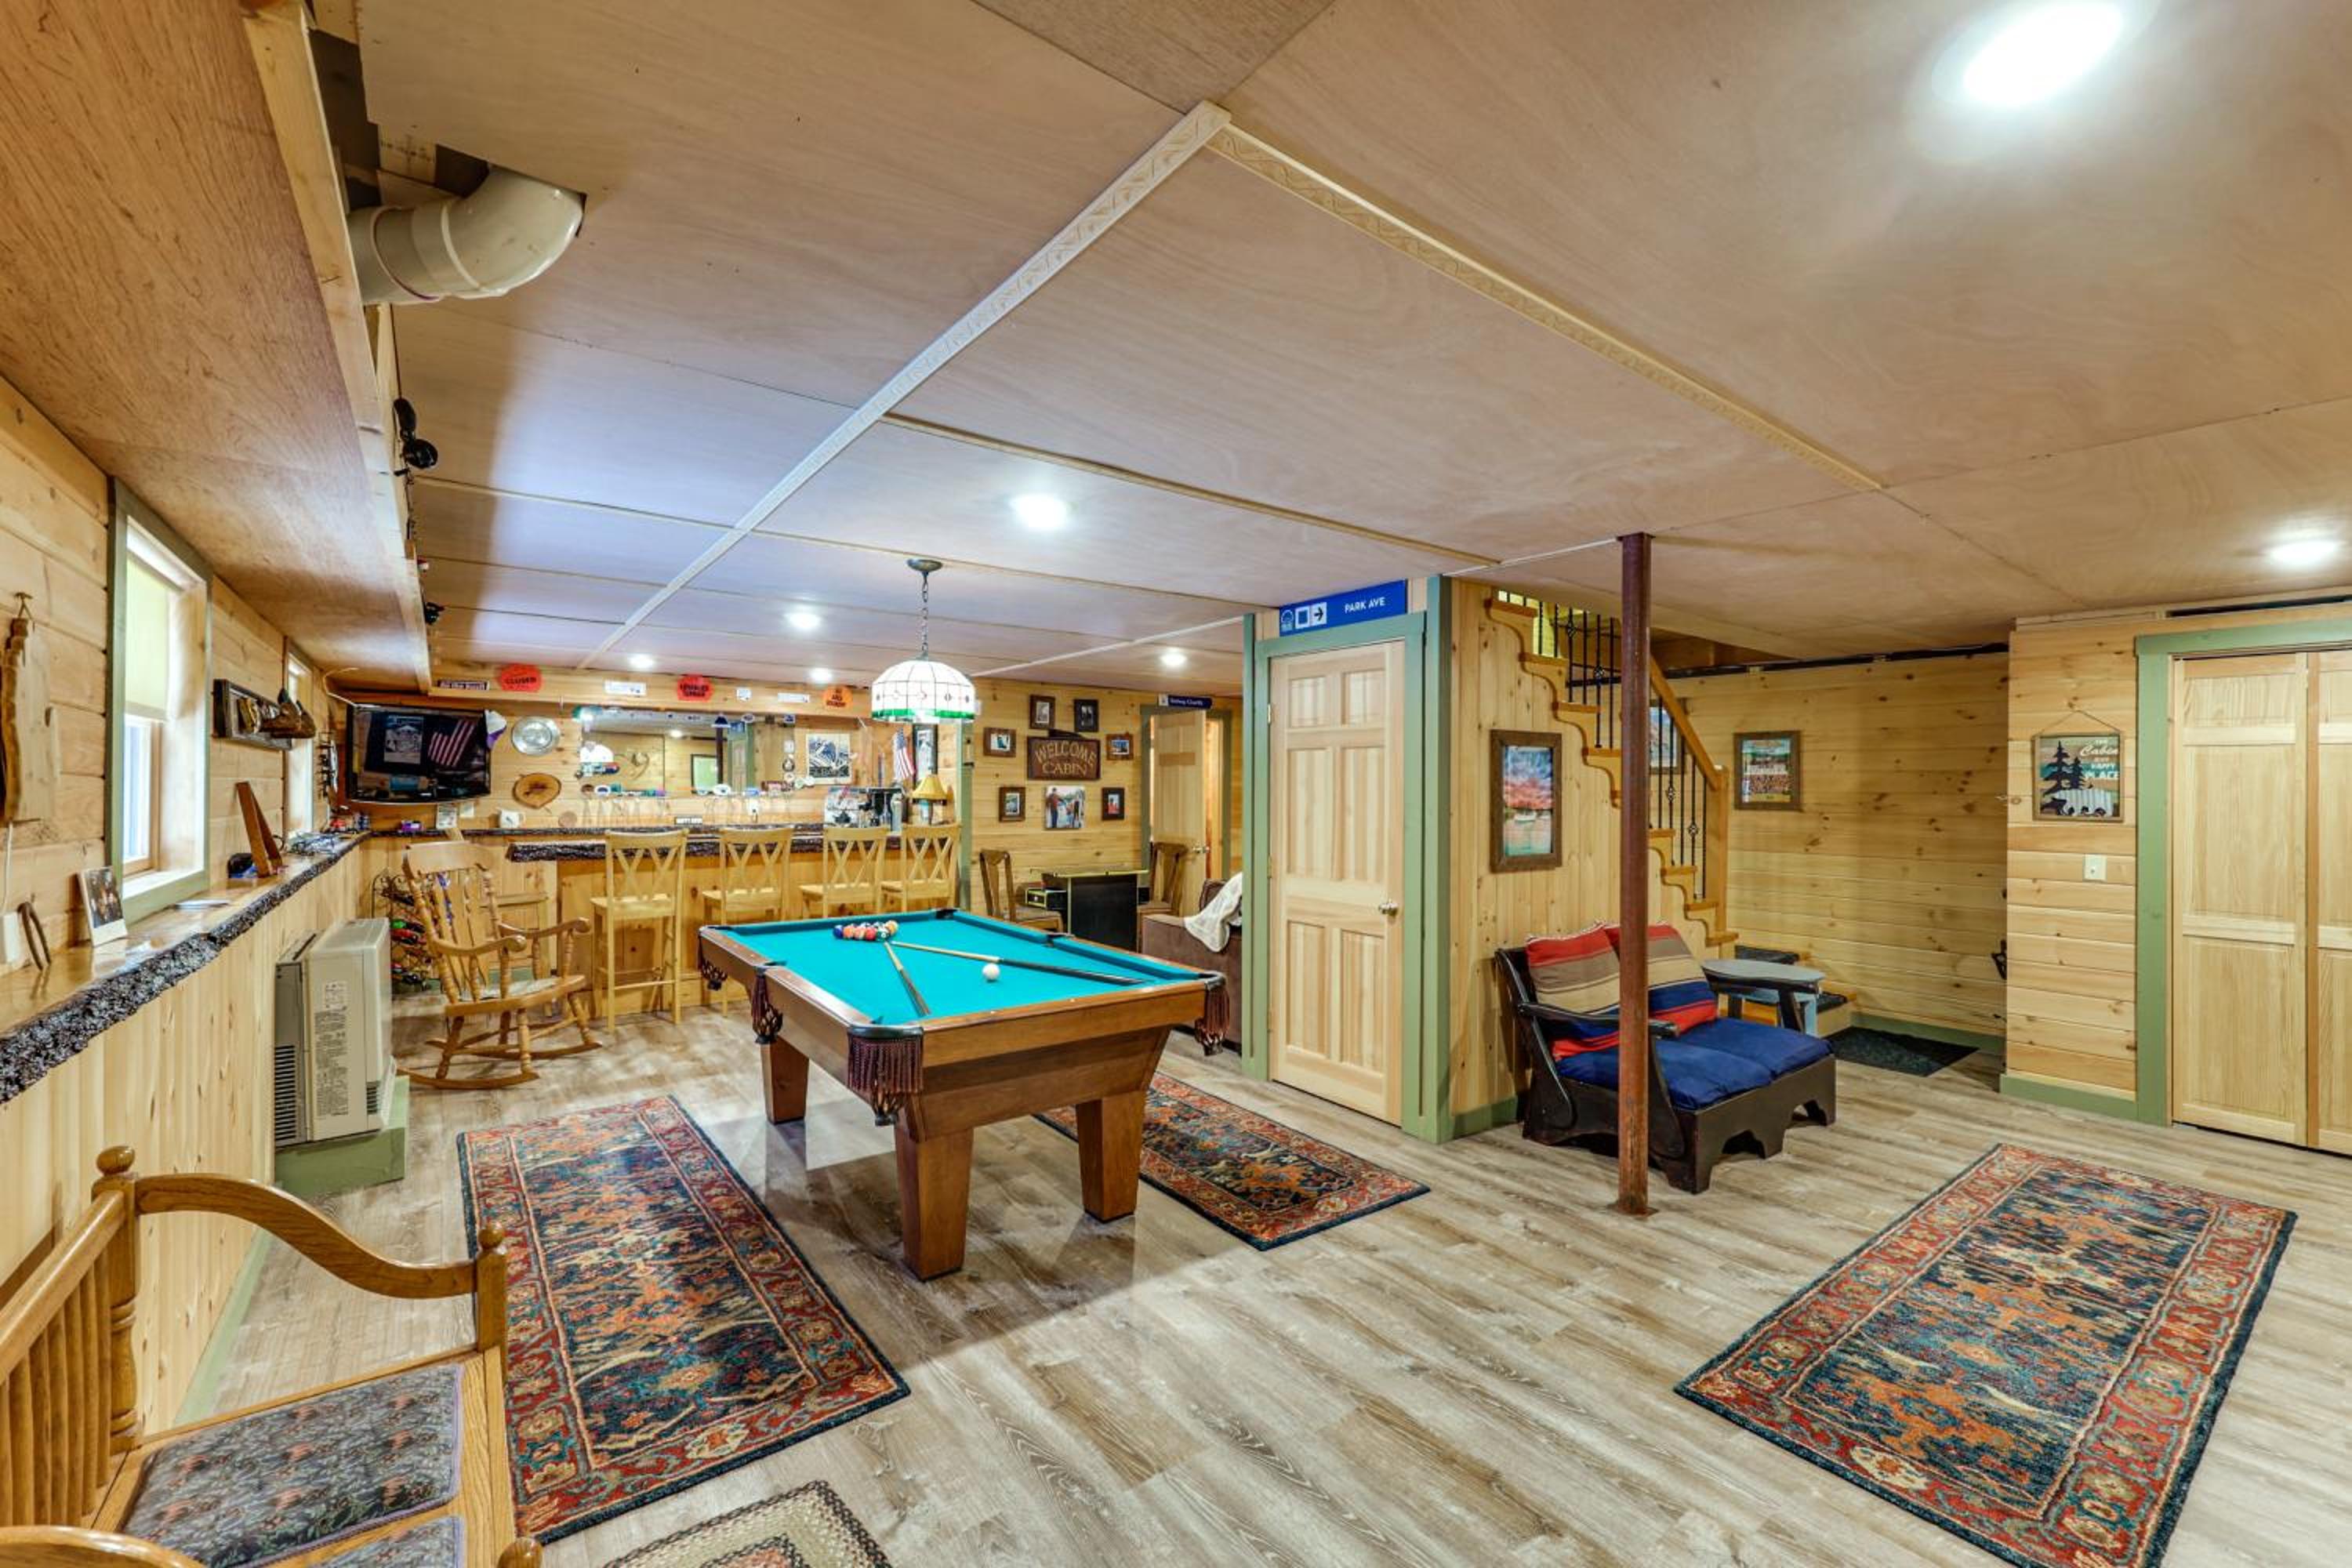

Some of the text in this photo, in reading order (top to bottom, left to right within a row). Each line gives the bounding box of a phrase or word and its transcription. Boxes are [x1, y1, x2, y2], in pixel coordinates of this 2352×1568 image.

[1345, 597, 1386, 614] PARK AVE
[1036, 739, 1097, 767] WELCOME
[2080, 745, 2118, 757] Cabin
[1042, 760, 1087, 776] CABIN
[2085, 771, 2119, 780] PLACE
